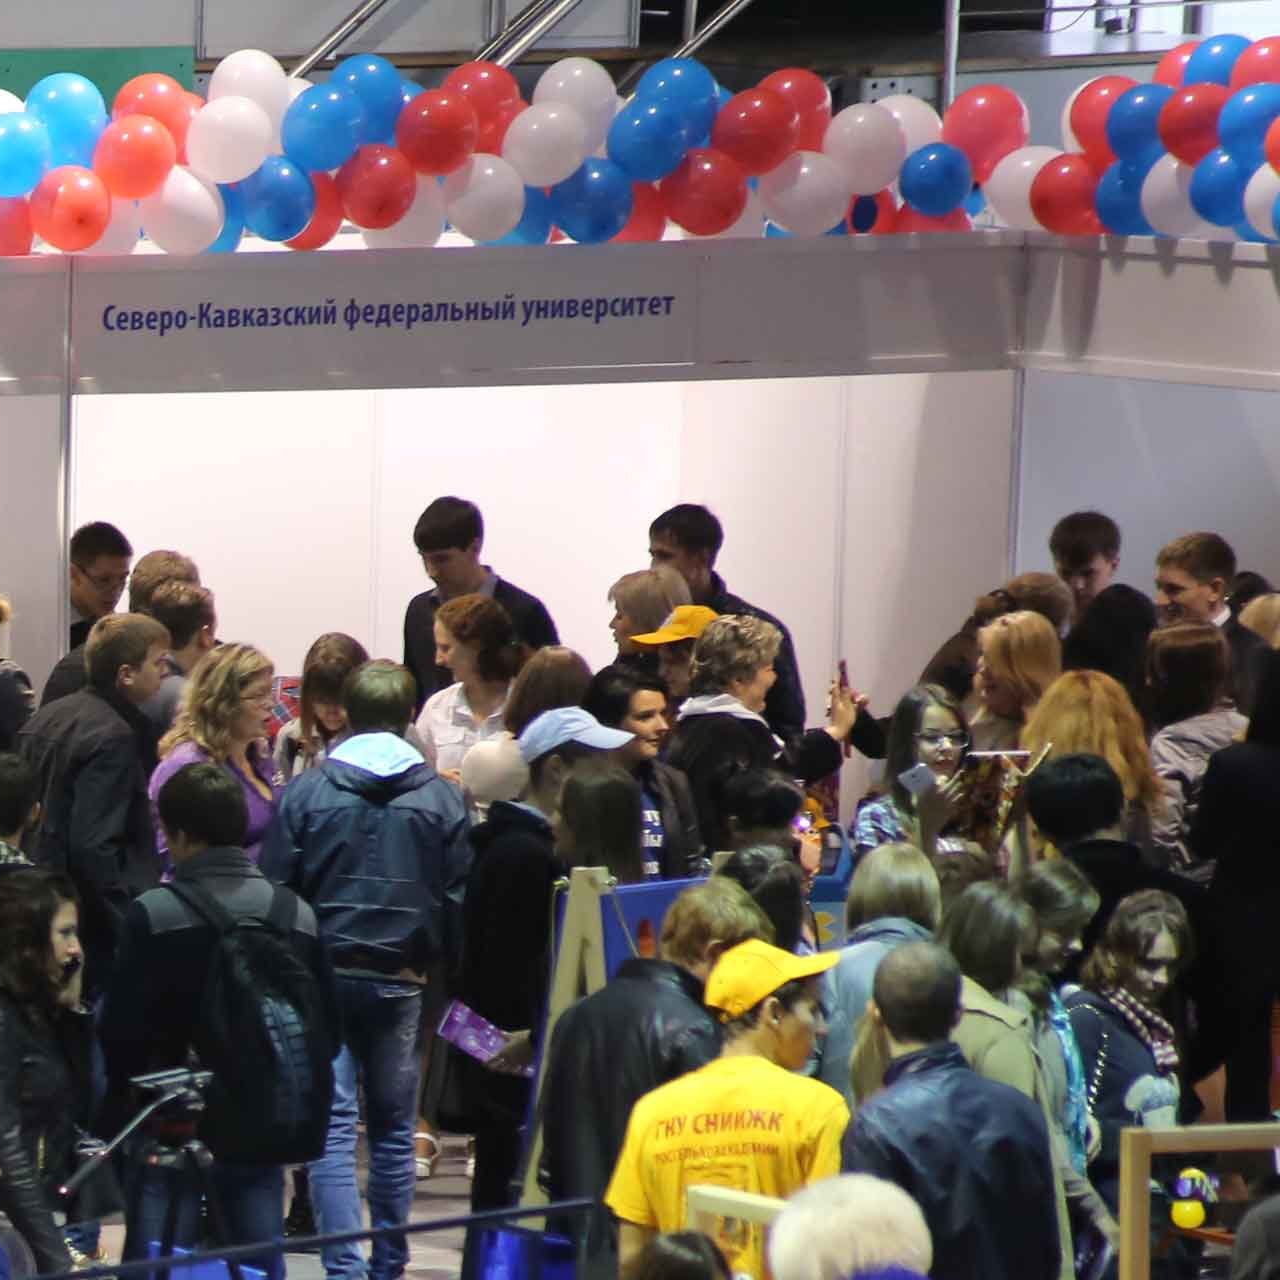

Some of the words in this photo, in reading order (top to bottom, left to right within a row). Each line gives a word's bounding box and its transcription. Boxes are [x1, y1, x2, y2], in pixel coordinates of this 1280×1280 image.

[102, 299, 337, 336] Северо-Кавказский
[343, 293, 516, 331] федеральный
[521, 295, 676, 327] университет
